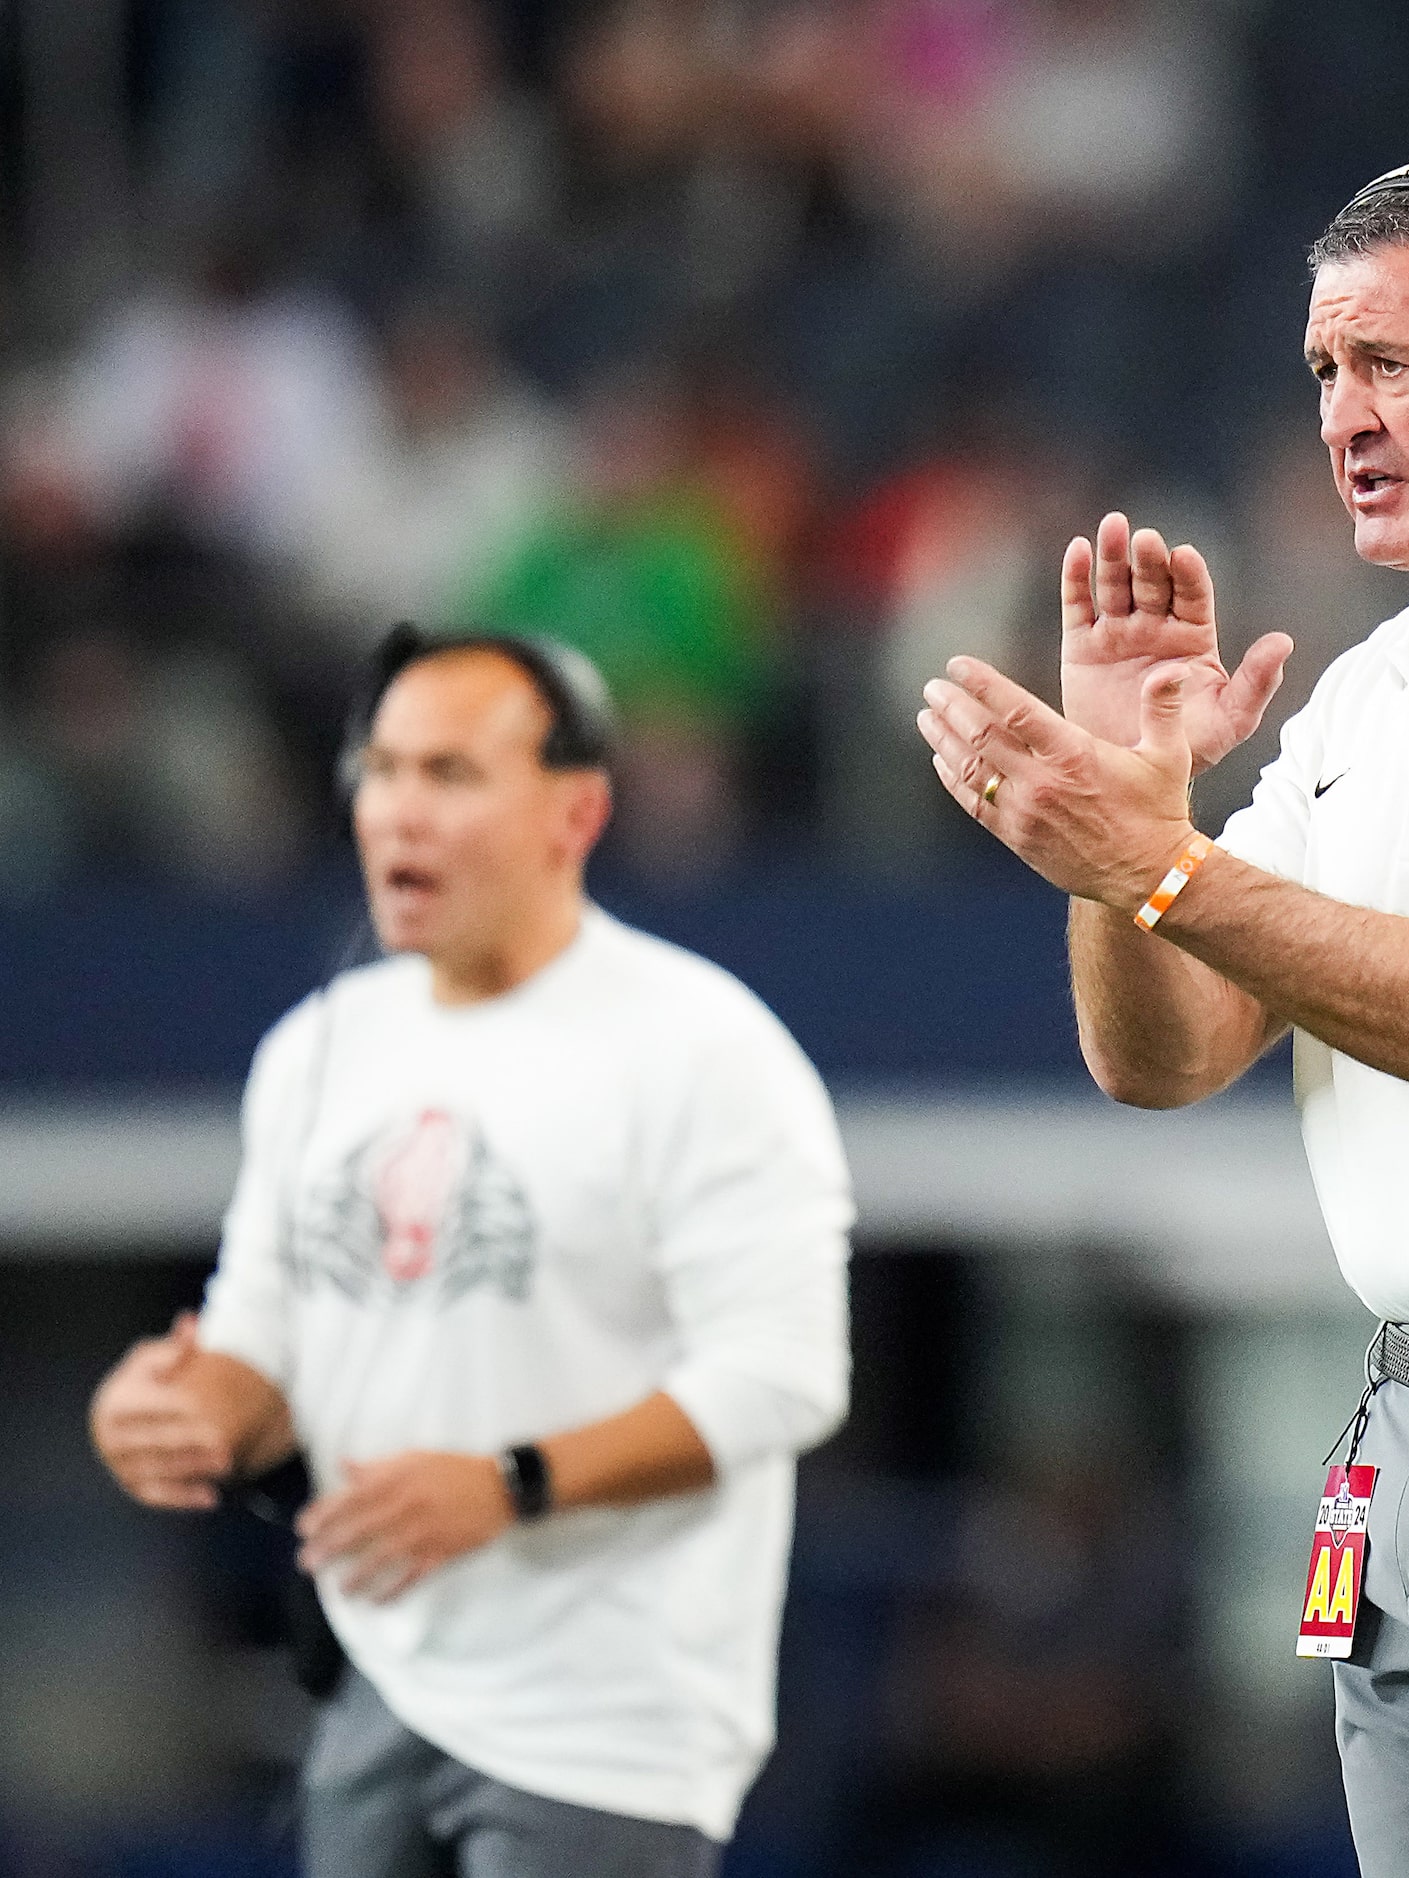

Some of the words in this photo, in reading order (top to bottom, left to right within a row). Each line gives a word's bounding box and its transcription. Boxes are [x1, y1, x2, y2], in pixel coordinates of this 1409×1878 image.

[1318, 1504, 1330, 1525] 20
[1330, 1509, 1353, 1525] STATE
[1354, 1505, 1366, 1526] 24
[1303, 1546, 1354, 1624] AA
